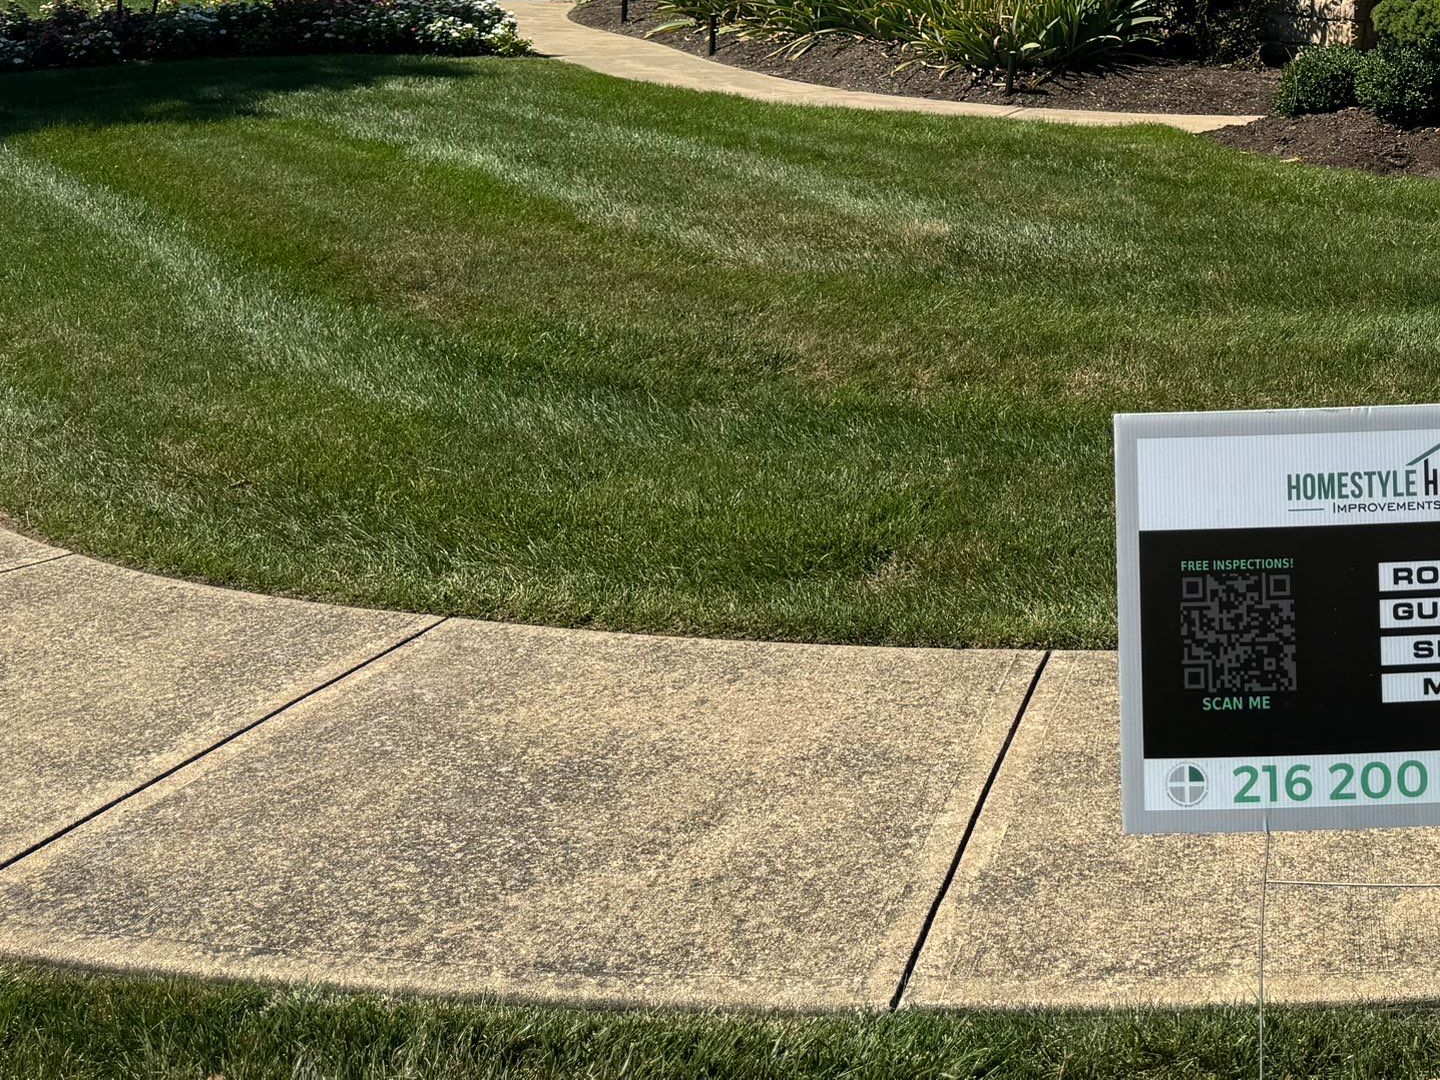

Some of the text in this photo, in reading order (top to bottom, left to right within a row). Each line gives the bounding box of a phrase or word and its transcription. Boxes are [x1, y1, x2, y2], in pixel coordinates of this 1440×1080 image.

[1287, 469, 1418, 501] HOMESTYLE
[1180, 558, 1294, 571] FREE INSPECTIONS!
[1202, 695, 1271, 711] SCAN ME
[1232, 764, 1313, 803] 216
[1328, 759, 1428, 800] 200
